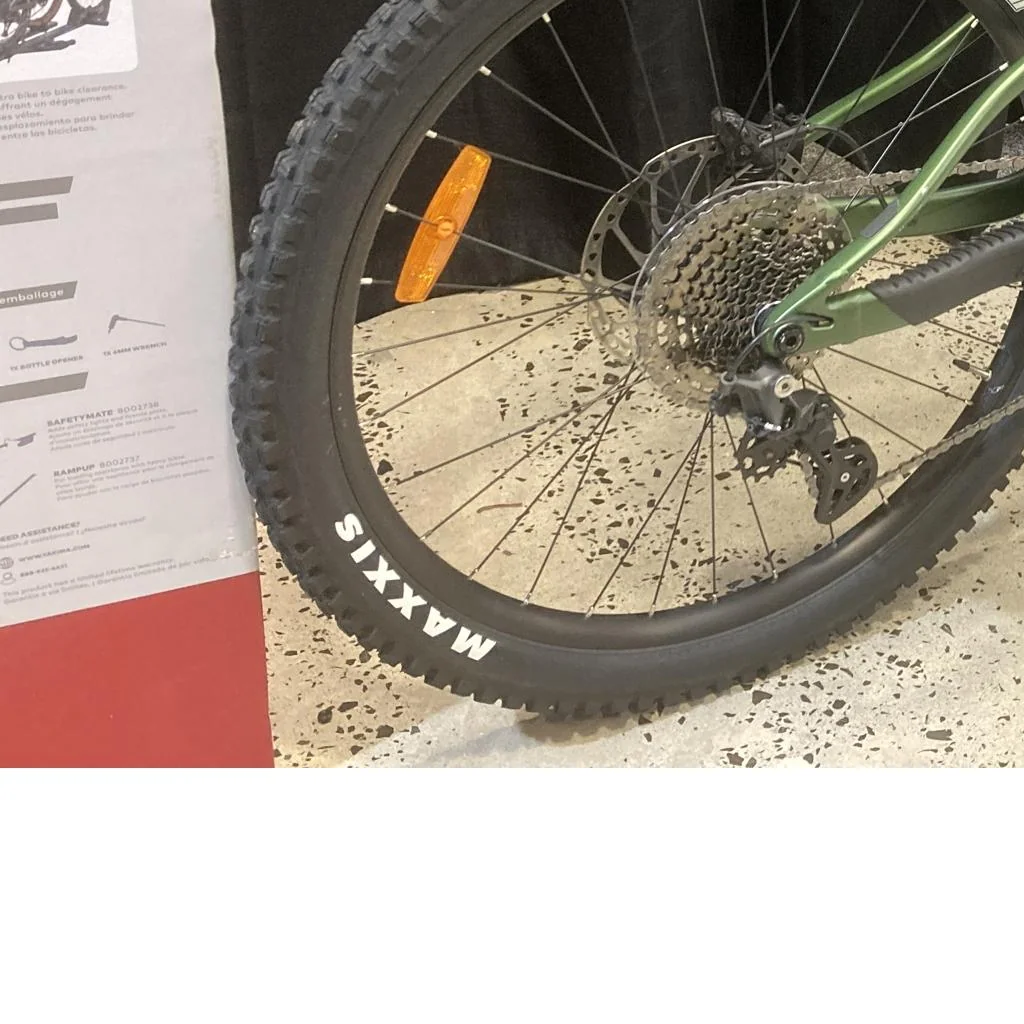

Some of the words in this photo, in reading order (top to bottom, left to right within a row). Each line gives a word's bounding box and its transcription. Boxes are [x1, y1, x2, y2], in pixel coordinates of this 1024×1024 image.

[17, 90, 39, 100] bike
[40, 89, 52, 98] to
[54, 86, 75, 97] bike
[34, 100, 47, 108] un
[0, 288, 65, 305] emballage
[46, 408, 114, 427] SAFETYMATE
[53, 463, 96, 477] RAMPUP
[334, 512, 497, 662] MAXXIS
